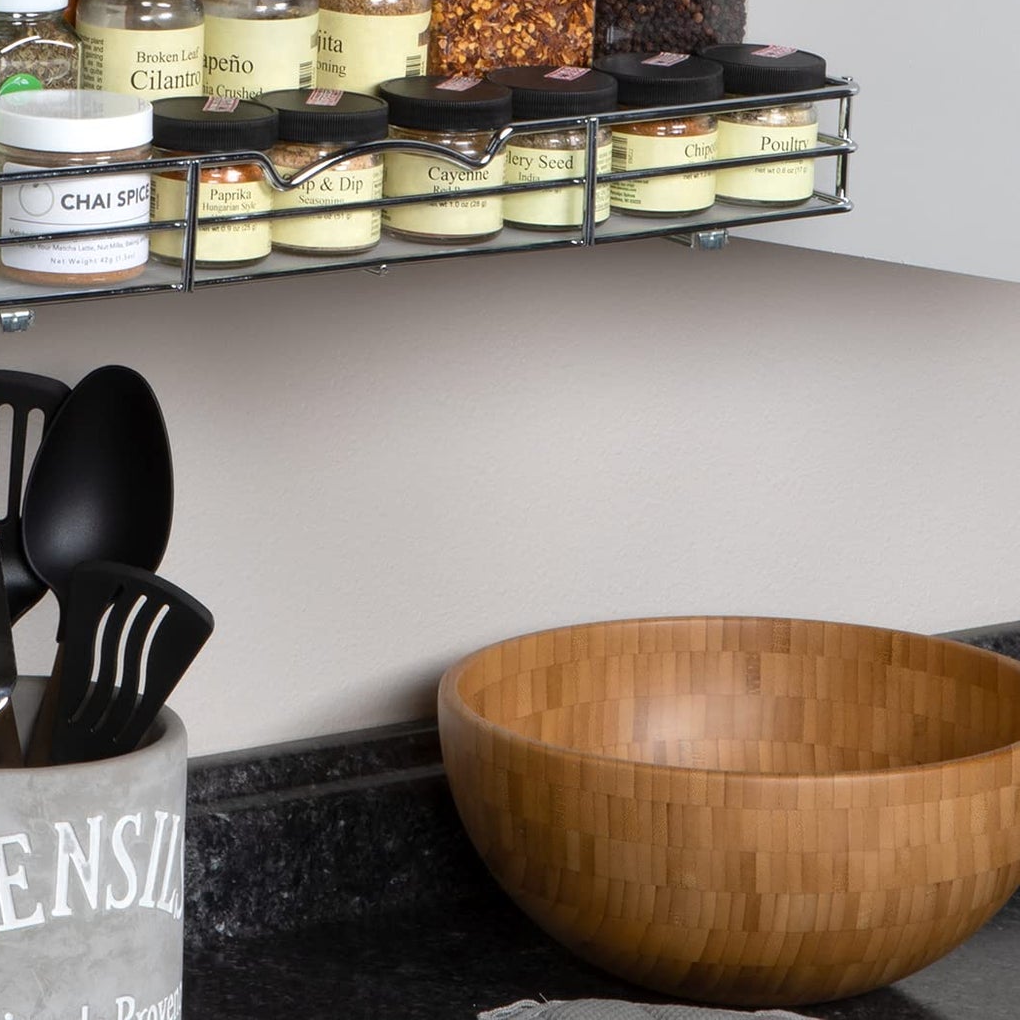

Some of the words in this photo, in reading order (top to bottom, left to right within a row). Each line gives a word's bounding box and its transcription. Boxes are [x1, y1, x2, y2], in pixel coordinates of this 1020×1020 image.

[137, 50, 179, 64] Broken
[181, 46, 200, 62] Leaf
[130, 68, 201, 90] Cilantro
[216, 84, 263, 100] Crushed
[760, 136, 809, 153] Poultry
[538, 155, 574, 170] Seed
[428, 166, 490, 182] Cayenne
[518, 172, 540, 182] India
[320, 176, 333, 192] &
[339, 176, 364, 194] Dip
[60, 193, 111, 210] CHAI
[117, 183, 150, 208] SPICE
[210, 188, 252, 204] Paprika
[298, 196, 344, 205] Seasoning
[202, 202, 240, 213] Hungarian
[241, 202, 256, 211] Style
